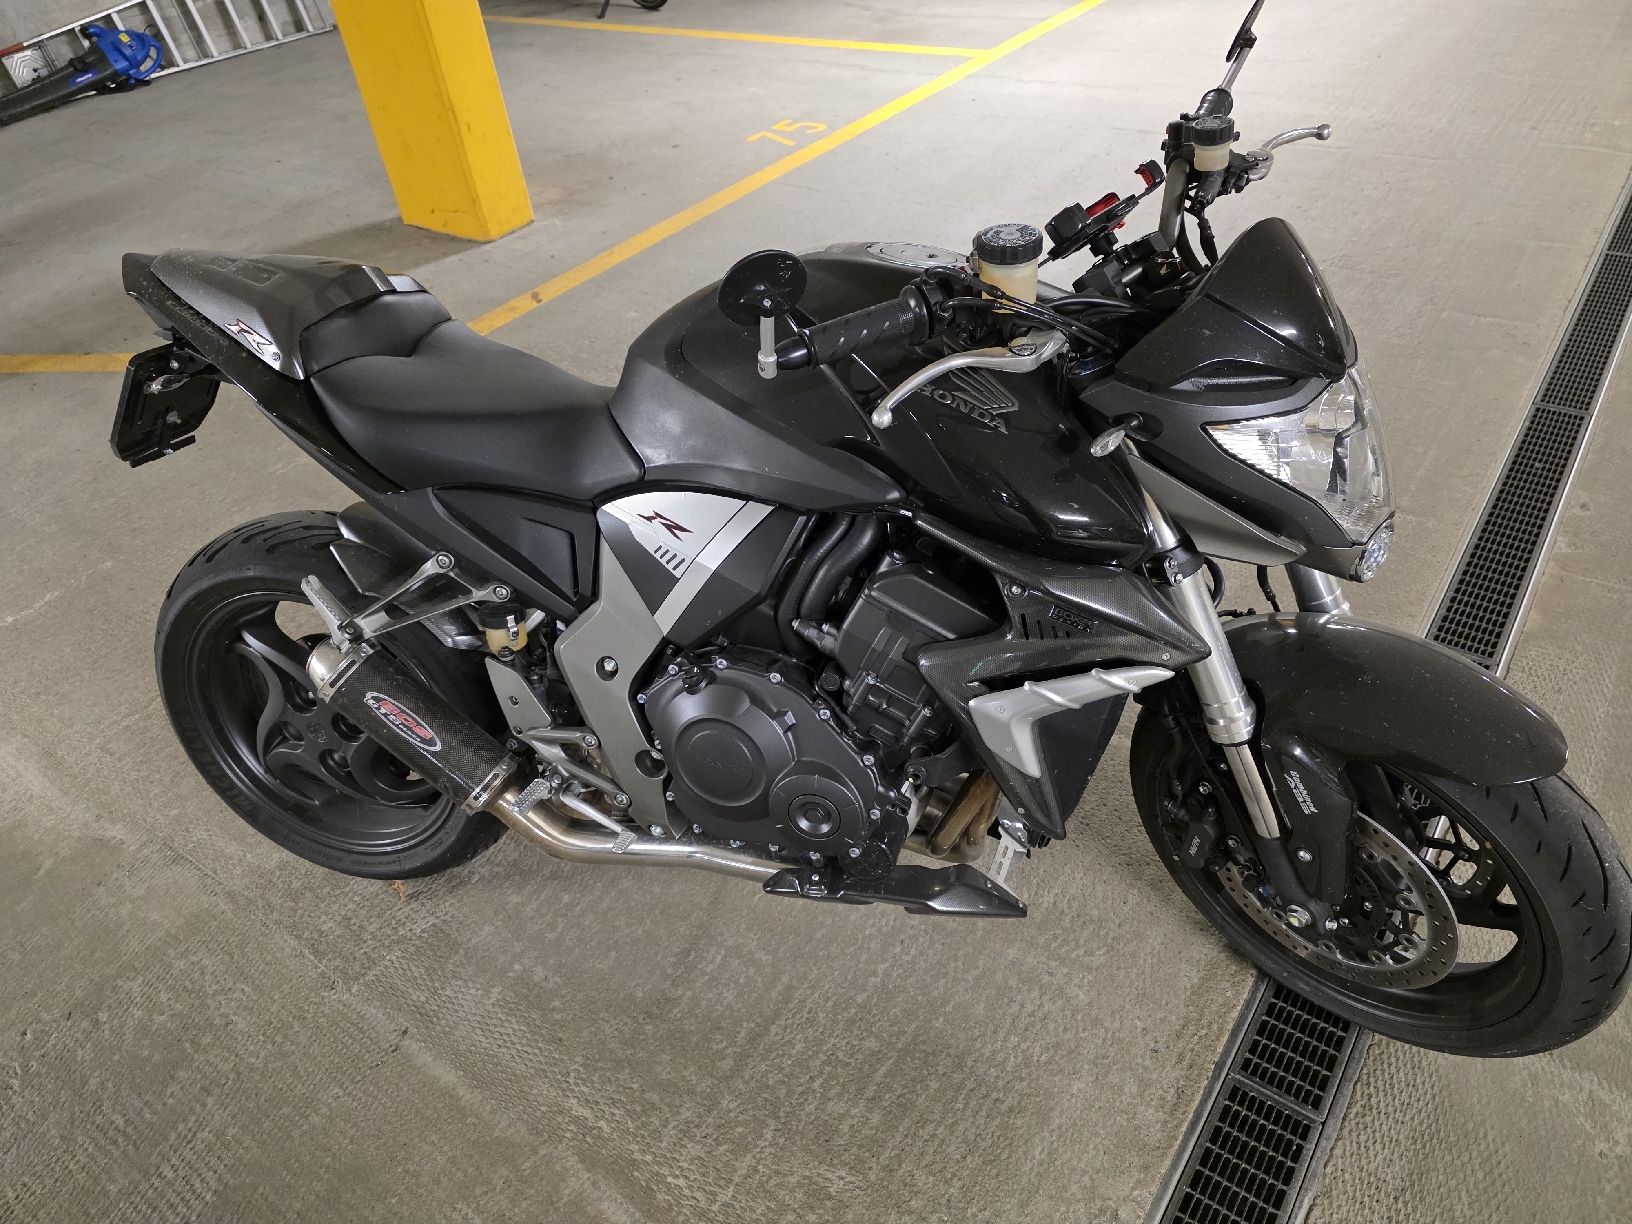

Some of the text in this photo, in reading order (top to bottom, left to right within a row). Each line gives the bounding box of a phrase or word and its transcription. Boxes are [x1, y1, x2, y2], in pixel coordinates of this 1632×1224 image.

[744, 118, 828, 146] 75
[915, 383, 1009, 434] HONDA
[378, 699, 434, 740] BOS
[1283, 773, 1312, 815] ABS
[1289, 770, 1319, 813] Combined
